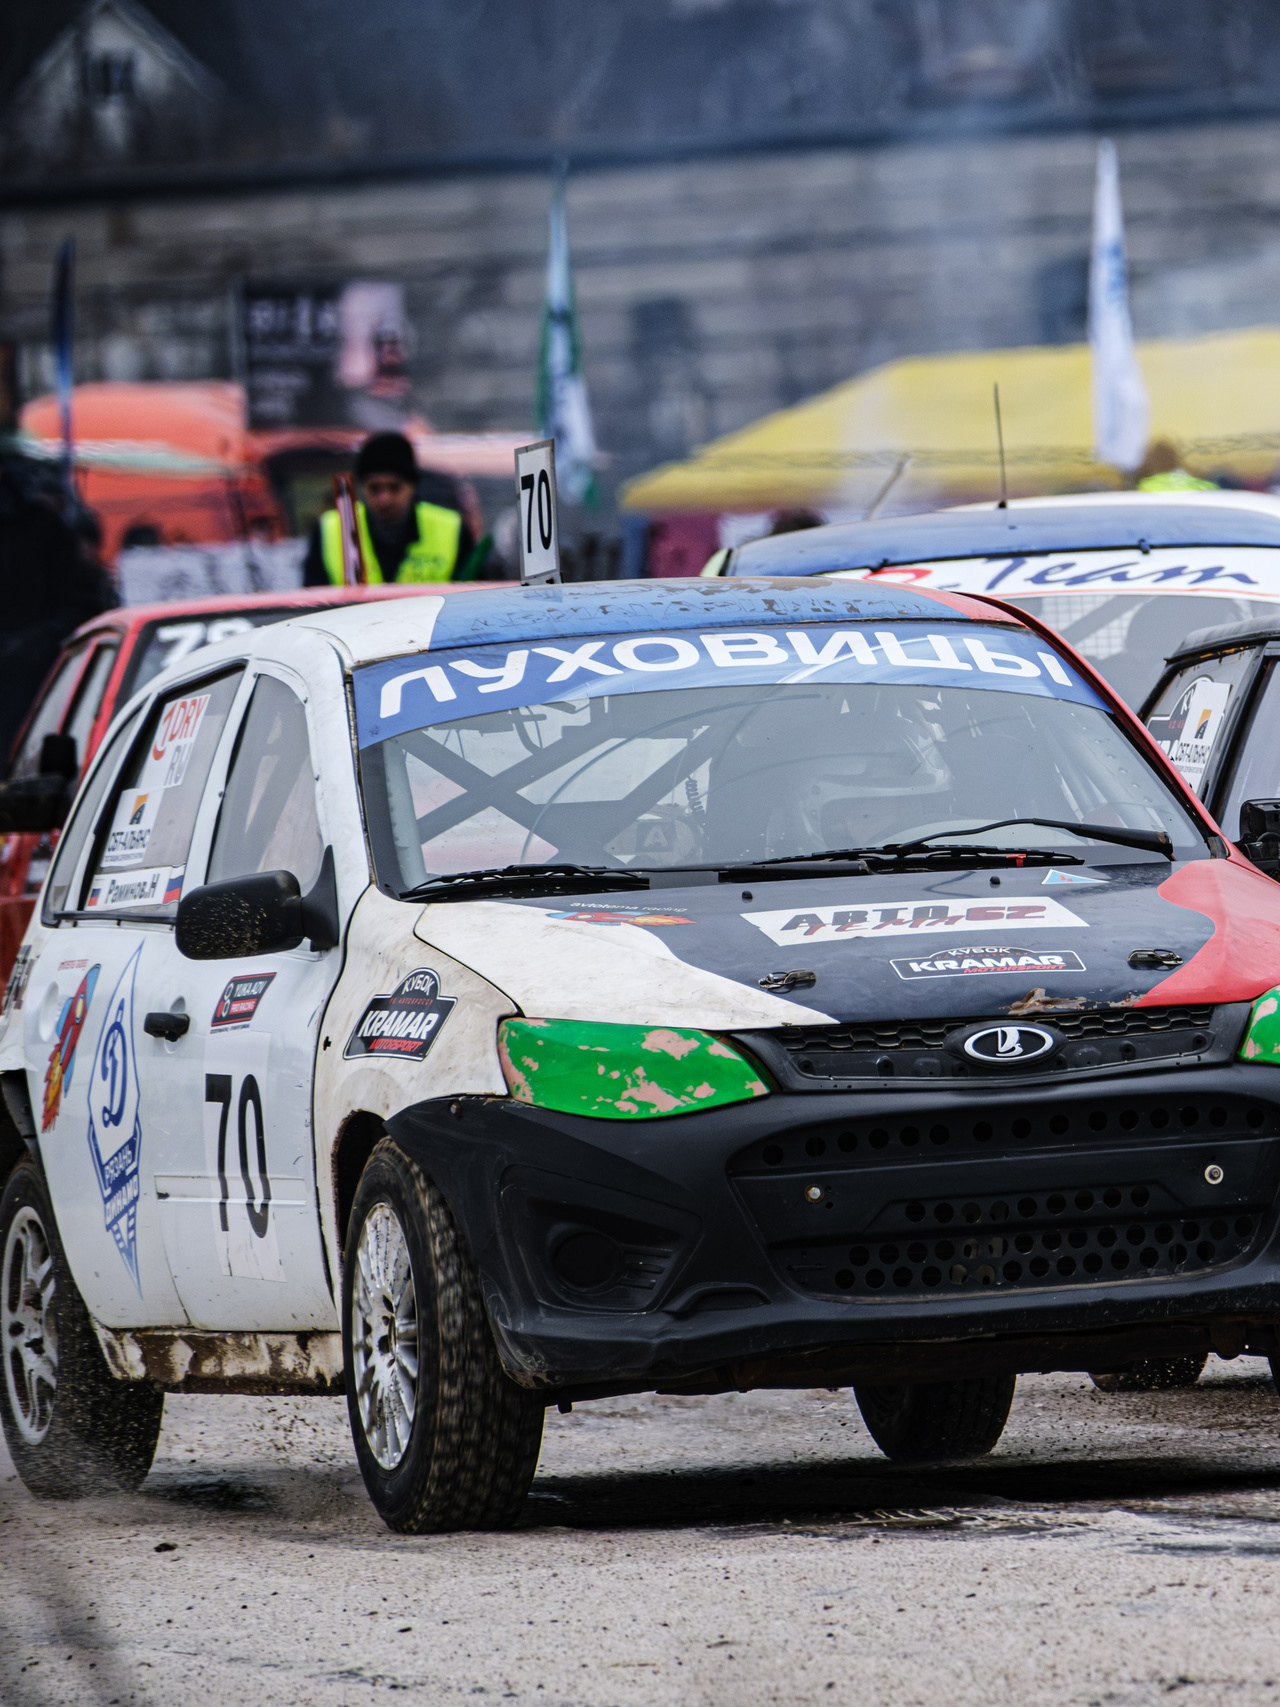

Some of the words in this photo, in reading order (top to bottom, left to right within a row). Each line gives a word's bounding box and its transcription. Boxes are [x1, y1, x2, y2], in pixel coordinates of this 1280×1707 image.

[521, 468, 552, 553] 70
[985, 555, 1261, 592] Team
[379, 630, 1073, 719] ЛУХОВИЦЫ
[965, 905, 1048, 921] 62
[909, 955, 1066, 973] KRAMAR
[948, 947, 1012, 957] КУБОК
[963, 964, 1067, 974] MOTORSPORT
[401, 974, 435, 996] КУБОК
[357, 1010, 439, 1040] KRAMAR
[369, 1038, 424, 1052] MOTORSPORT
[104, 1144, 133, 1188] РЯЗАНЬ
[205, 1073, 271, 1239] 70
[105, 1174, 139, 1226] ДИНАМО
